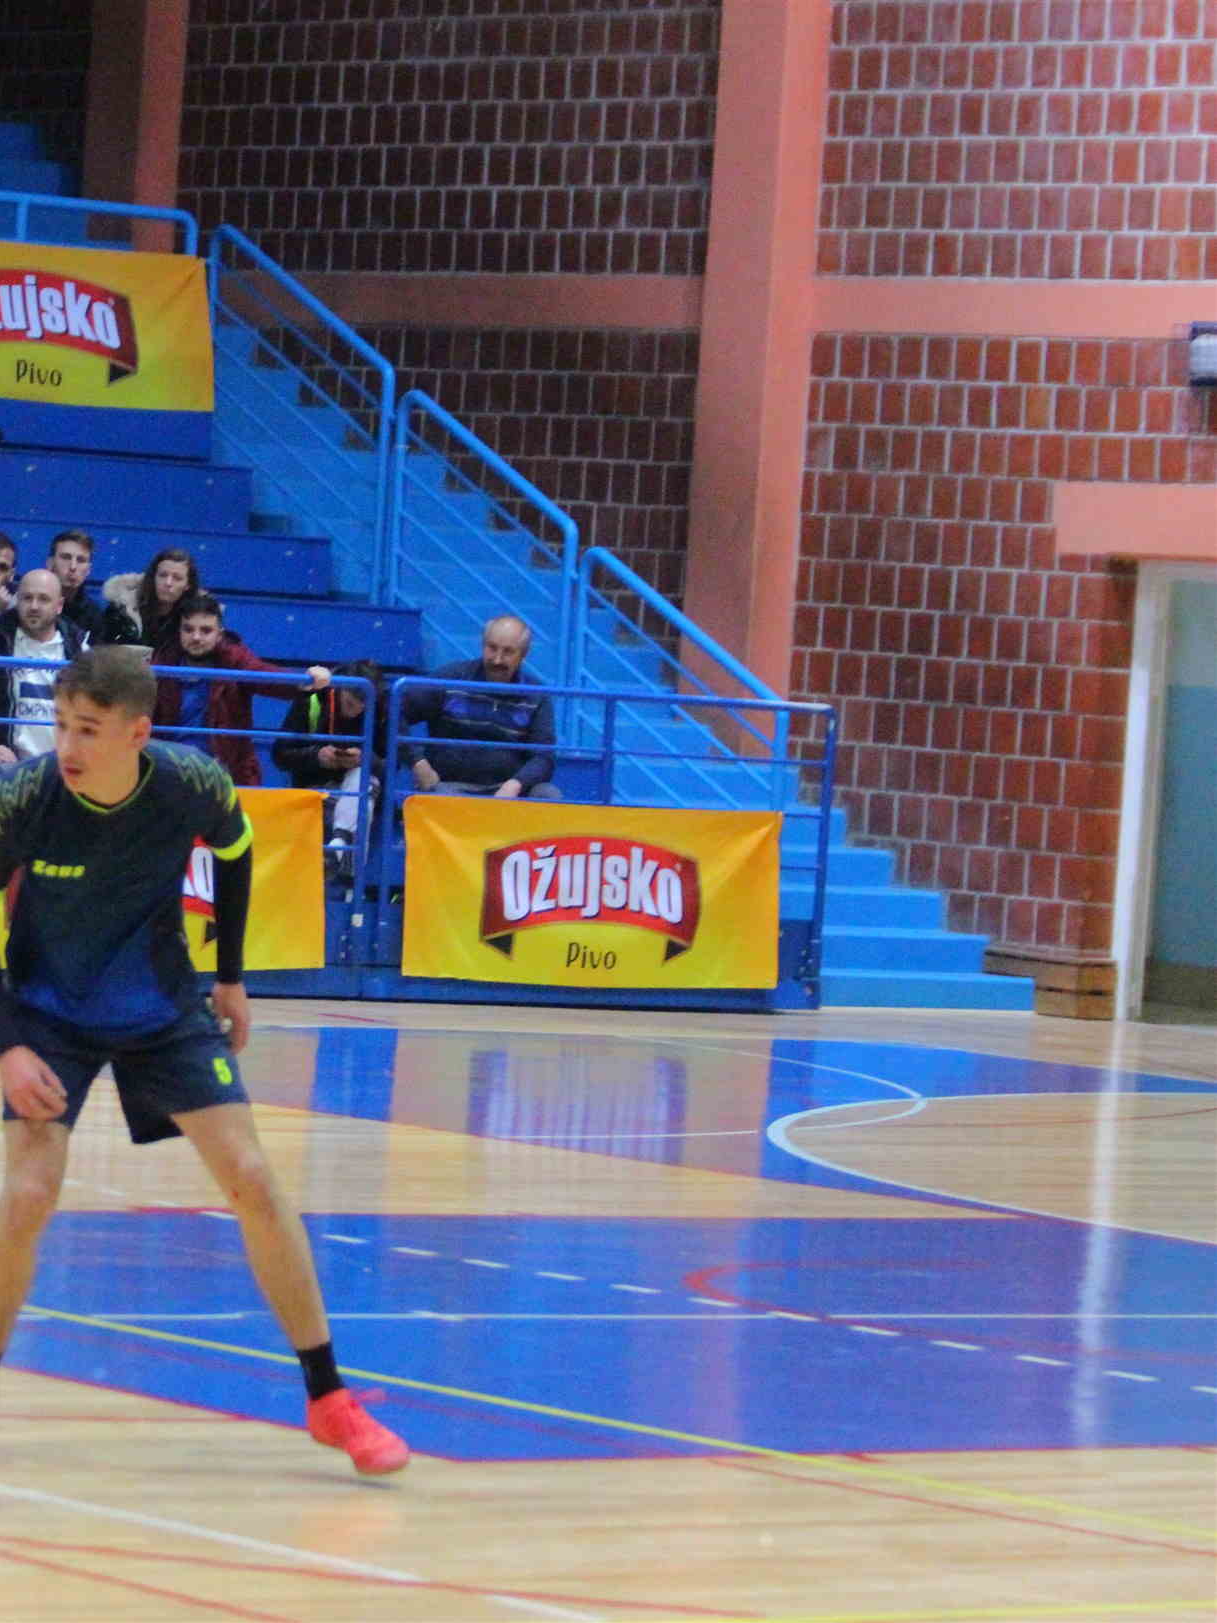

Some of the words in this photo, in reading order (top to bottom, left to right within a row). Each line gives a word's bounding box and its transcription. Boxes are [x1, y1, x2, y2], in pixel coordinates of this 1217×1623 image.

[15, 358, 63, 387] Pivo
[500, 841, 684, 924] Ožujsko
[565, 941, 617, 970] Pivo
